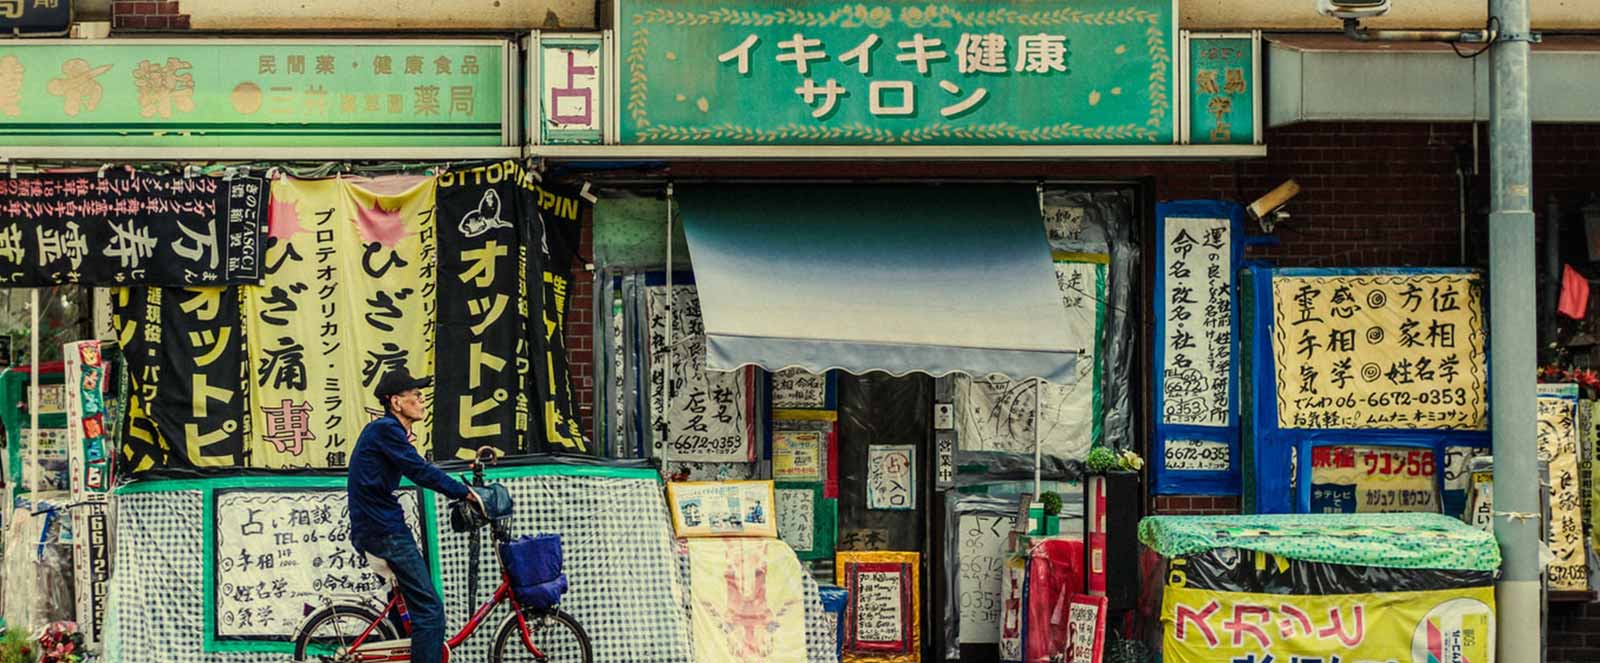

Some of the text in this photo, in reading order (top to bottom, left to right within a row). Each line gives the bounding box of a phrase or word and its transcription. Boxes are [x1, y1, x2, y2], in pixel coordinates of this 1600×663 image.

[257, 54, 481, 76] 民間薬・健康食品
[718, 33, 1068, 73] イキイキ健康
[551, 52, 595, 126] 占
[795, 79, 987, 118] サロン
[1292, 283, 1461, 326] 霊感 方位
[259, 236, 317, 470] ひざ痛専
[1296, 317, 1456, 360] 手相 家相
[1299, 353, 1460, 395] 気学 姓名学
[683, 387, 709, 432] 店名
[712, 385, 734, 424] 社名
[1166, 401, 1201, 415] 0353
[1294, 387, 1467, 410] でんわ 06-6672-0353
[274, 529, 351, 545] TEL 06-66
[237, 548, 275, 573] 手相
[232, 578, 289, 602] 姓名学
[960, 591, 1001, 610] 035
[1175, 600, 1364, 648] スカッと
